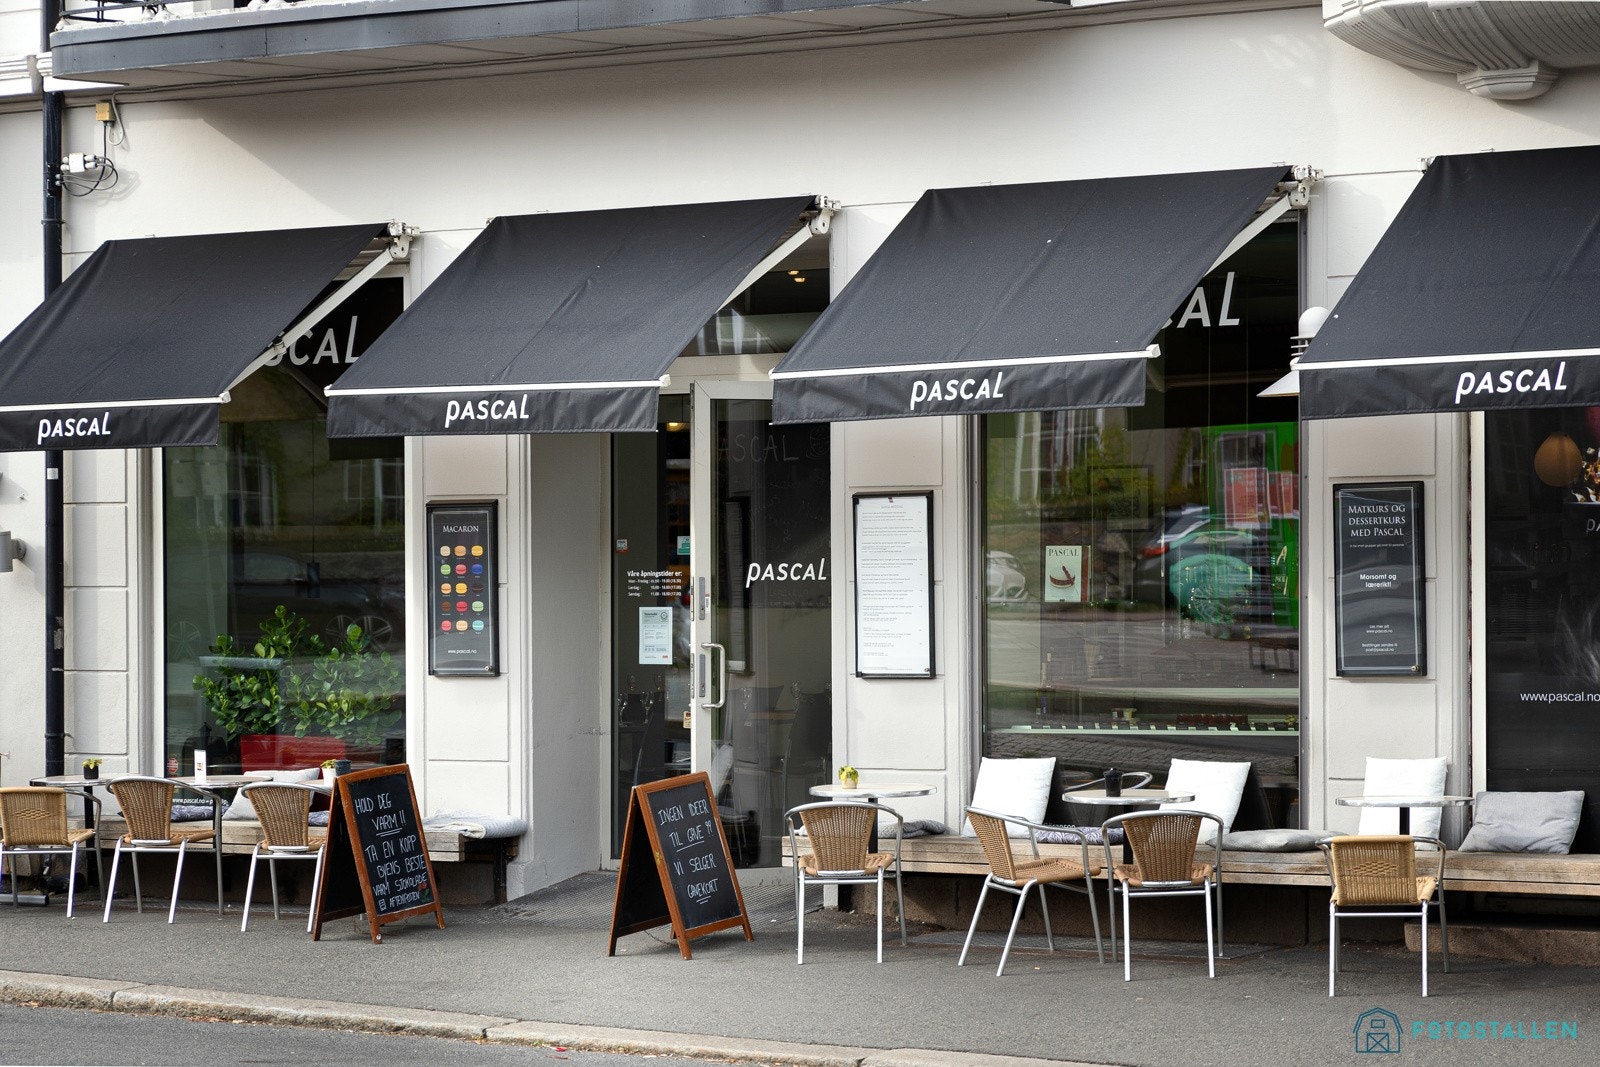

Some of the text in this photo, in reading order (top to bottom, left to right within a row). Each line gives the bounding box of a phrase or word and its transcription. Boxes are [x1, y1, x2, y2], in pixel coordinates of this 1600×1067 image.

[910, 371, 1004, 410] PASCAL
[1455, 361, 1567, 404] PASCAL
[444, 393, 529, 428] PASCAL
[37, 411, 111, 445] PASCAL
[1348, 504, 1406, 514] MATKURS OG
[442, 525, 479, 533] MACARON
[1348, 516, 1406, 526] DESSERTKURS
[1350, 529, 1371, 537] MED
[1048, 548, 1079, 557] PASCAL
[745, 558, 827, 588] PASCAL
[1520, 691, 1600, 704] www.pascal.no
[355, 792, 392, 815] HOLD DEG
[658, 799, 710, 826] INGEN IDEER
[372, 812, 399, 831] VARM
[669, 831, 684, 848] TIL
[687, 825, 705, 843] GAVE
[365, 835, 417, 863] TA EN KOPP
[376, 854, 427, 882] BYENS BESTE
[673, 853, 717, 876] VI SELGER
[372, 881, 391, 897] VARM
[687, 878, 719, 899] GAVEKORT
